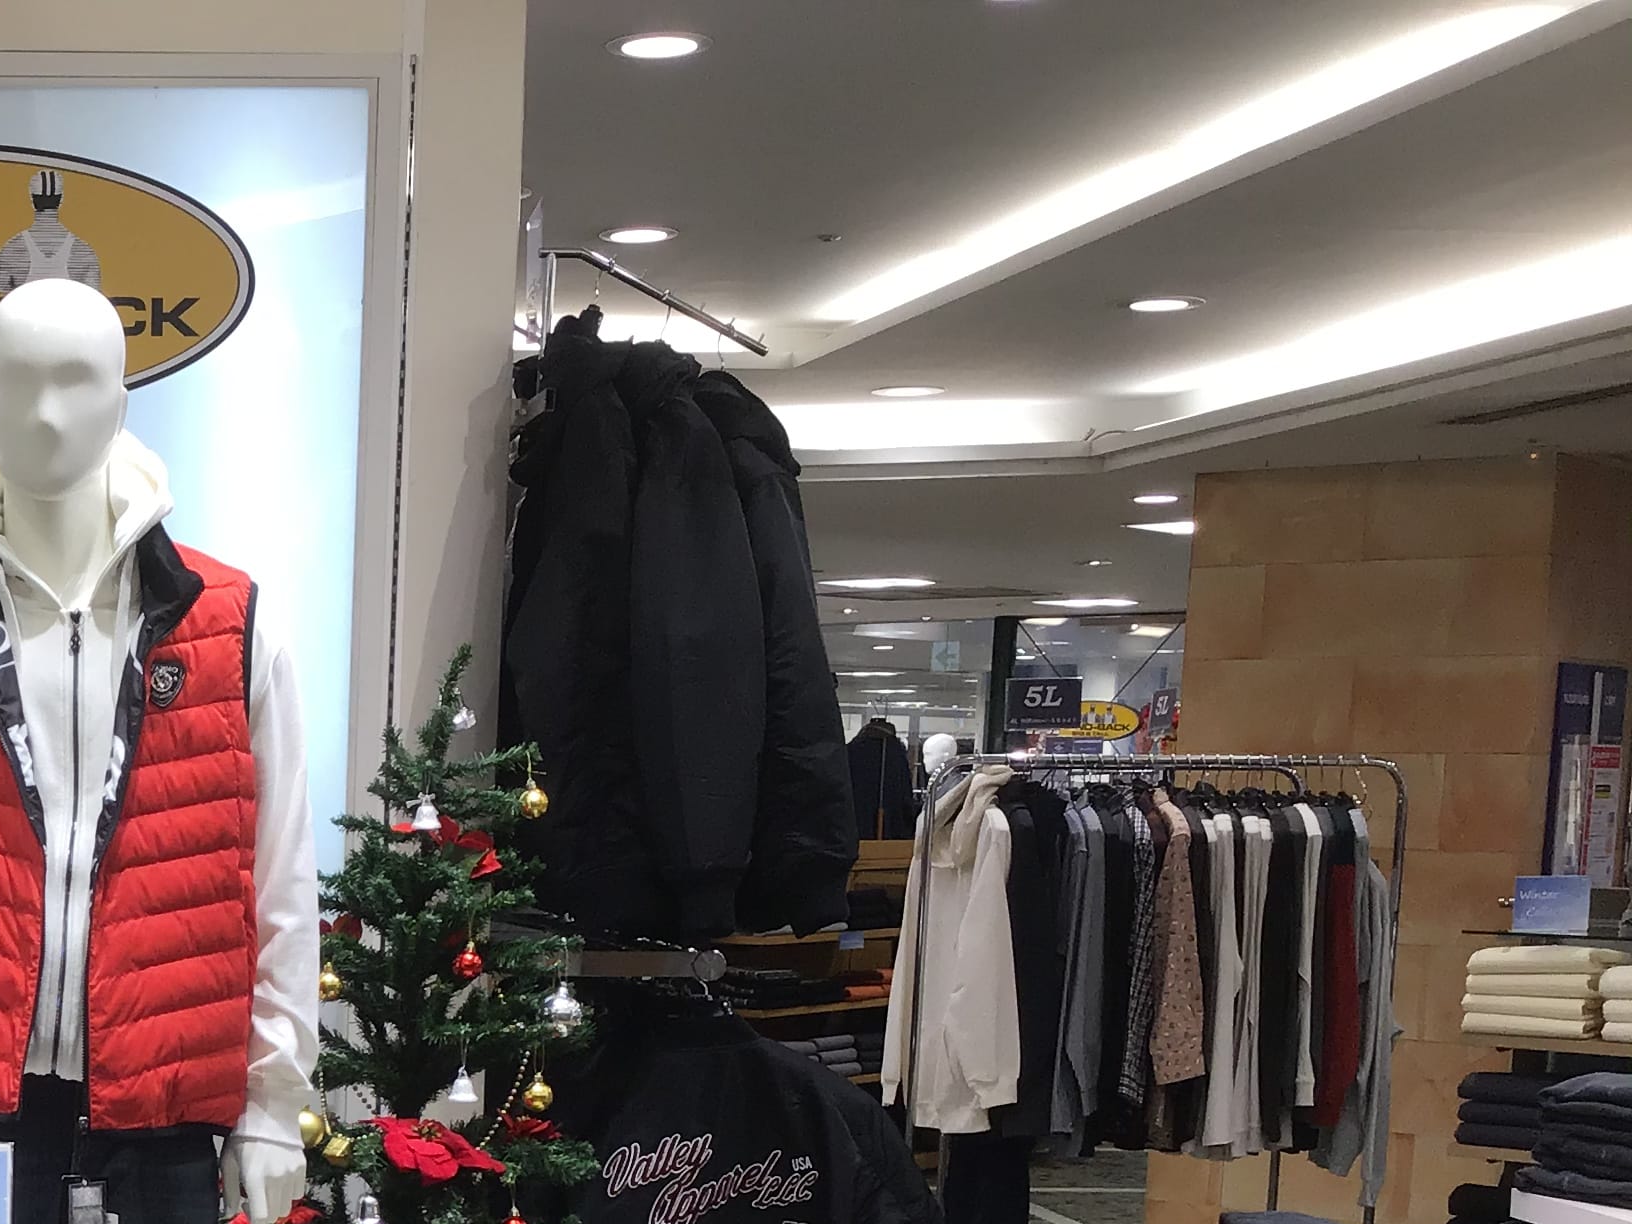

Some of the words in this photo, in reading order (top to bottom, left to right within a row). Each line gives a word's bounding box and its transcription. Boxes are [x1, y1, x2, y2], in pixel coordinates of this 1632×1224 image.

[1024, 685, 1063, 708] 5L
[603, 1133, 713, 1197] Valley
[792, 1156, 812, 1172] USA
